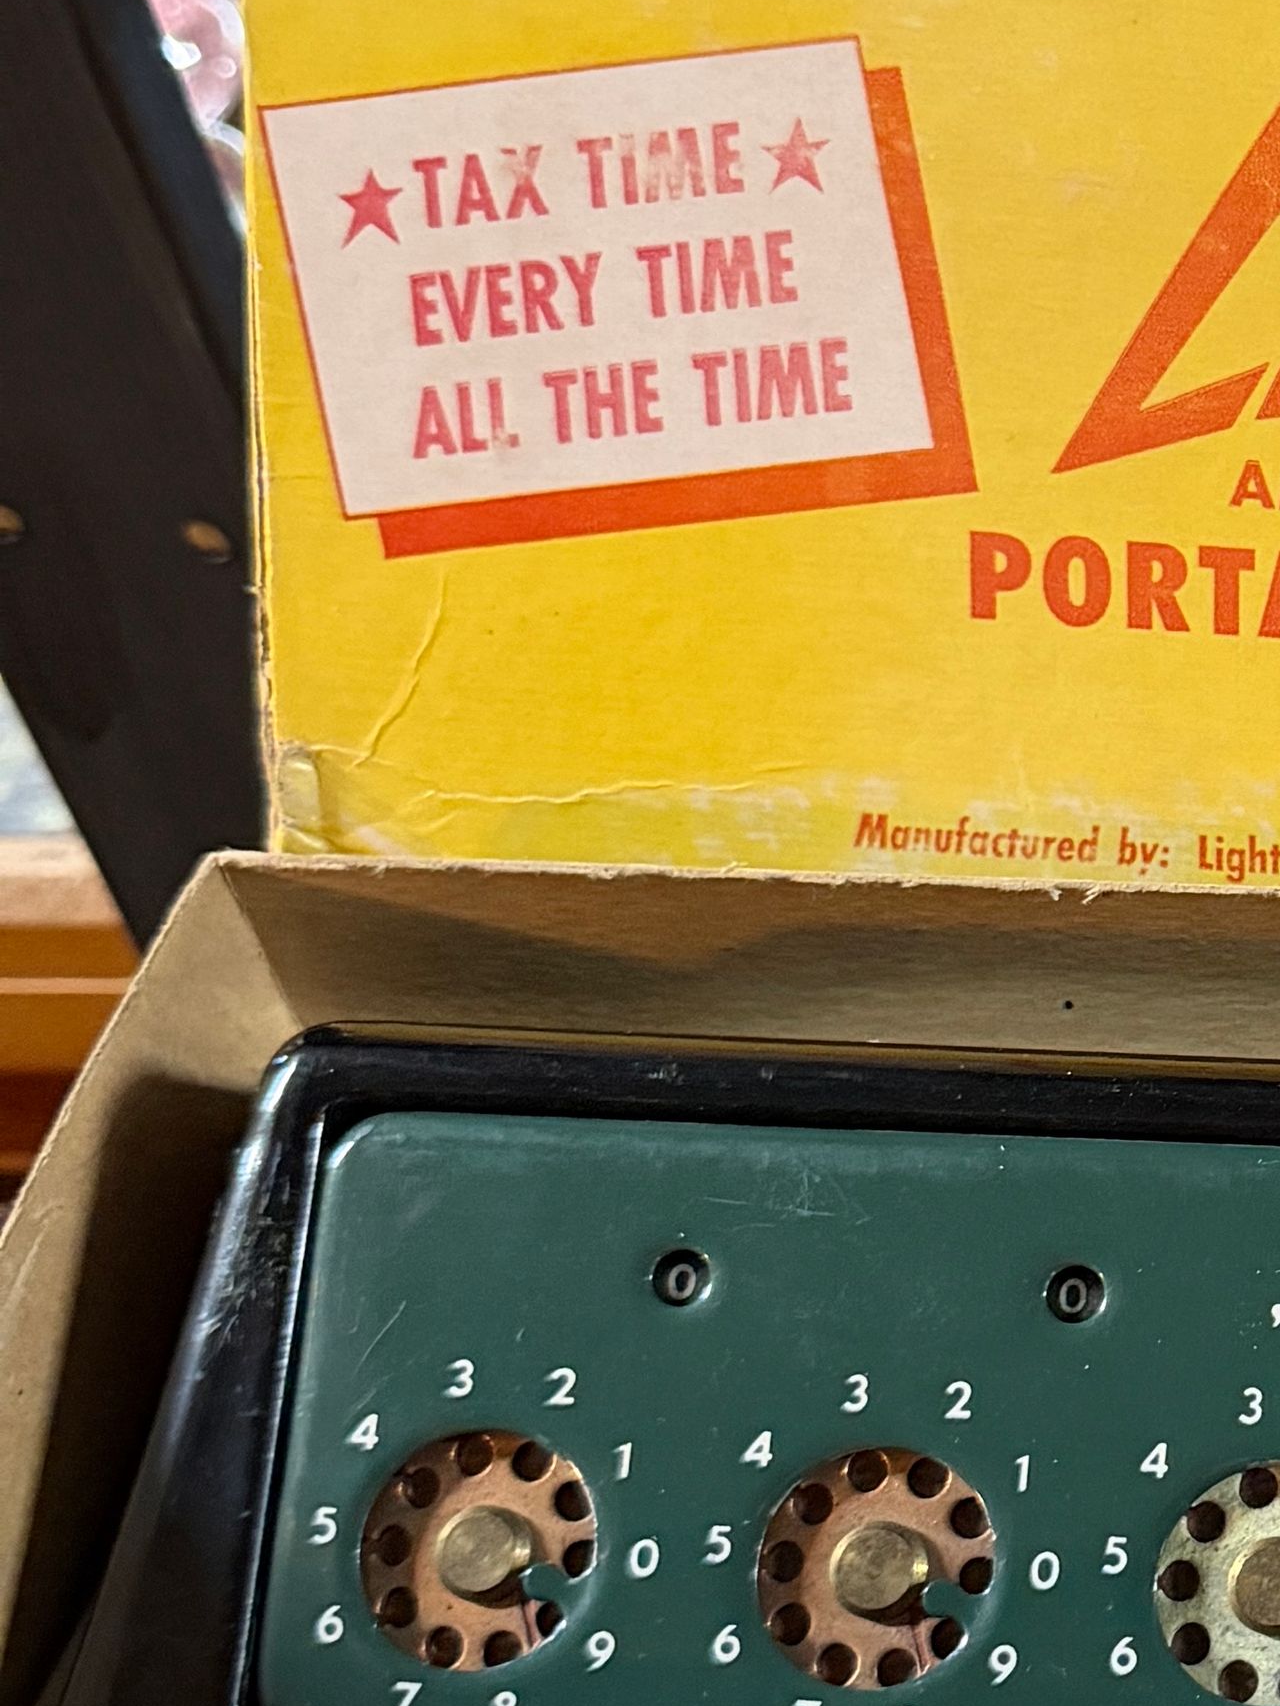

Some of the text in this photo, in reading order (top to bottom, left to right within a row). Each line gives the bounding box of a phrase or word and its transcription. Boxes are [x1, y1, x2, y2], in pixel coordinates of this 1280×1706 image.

[411, 121, 744, 229] TAX TIME
[408, 230, 799, 347] EVERY TIME
[412, 337, 853, 459] ALL THE TIME
[856, 814, 1098, 860] Manufactured
[1117, 826, 1170, 875] by:
[669, 1263, 696, 1299] 0
[1059, 1278, 1087, 1313] 0
[445, 1358, 474, 1398] 3
[546, 1367, 577, 1405] 2
[841, 1373, 869, 1413] 3
[944, 1380, 972, 1420] 2
[1238, 1386, 1263, 1425] 3
[347, 1413, 379, 1450] 4
[742, 1430, 773, 1467] 4
[616, 1442, 632, 1479] 1
[1015, 1454, 1030, 1492] 1
[1139, 1442, 1169, 1479] 4
[310, 1506, 338, 1545] 5
[705, 1525, 732, 1563] 5
[628, 1538, 660, 1578] 0
[1030, 1551, 1060, 1590] 0
[1102, 1535, 1128, 1575] 5
[316, 1605, 344, 1644] 6
[712, 1624, 741, 1663] 6
[586, 1630, 616, 1670] 9
[989, 1644, 1018, 1684] 9
[1110, 1636, 1138, 1676] 6
